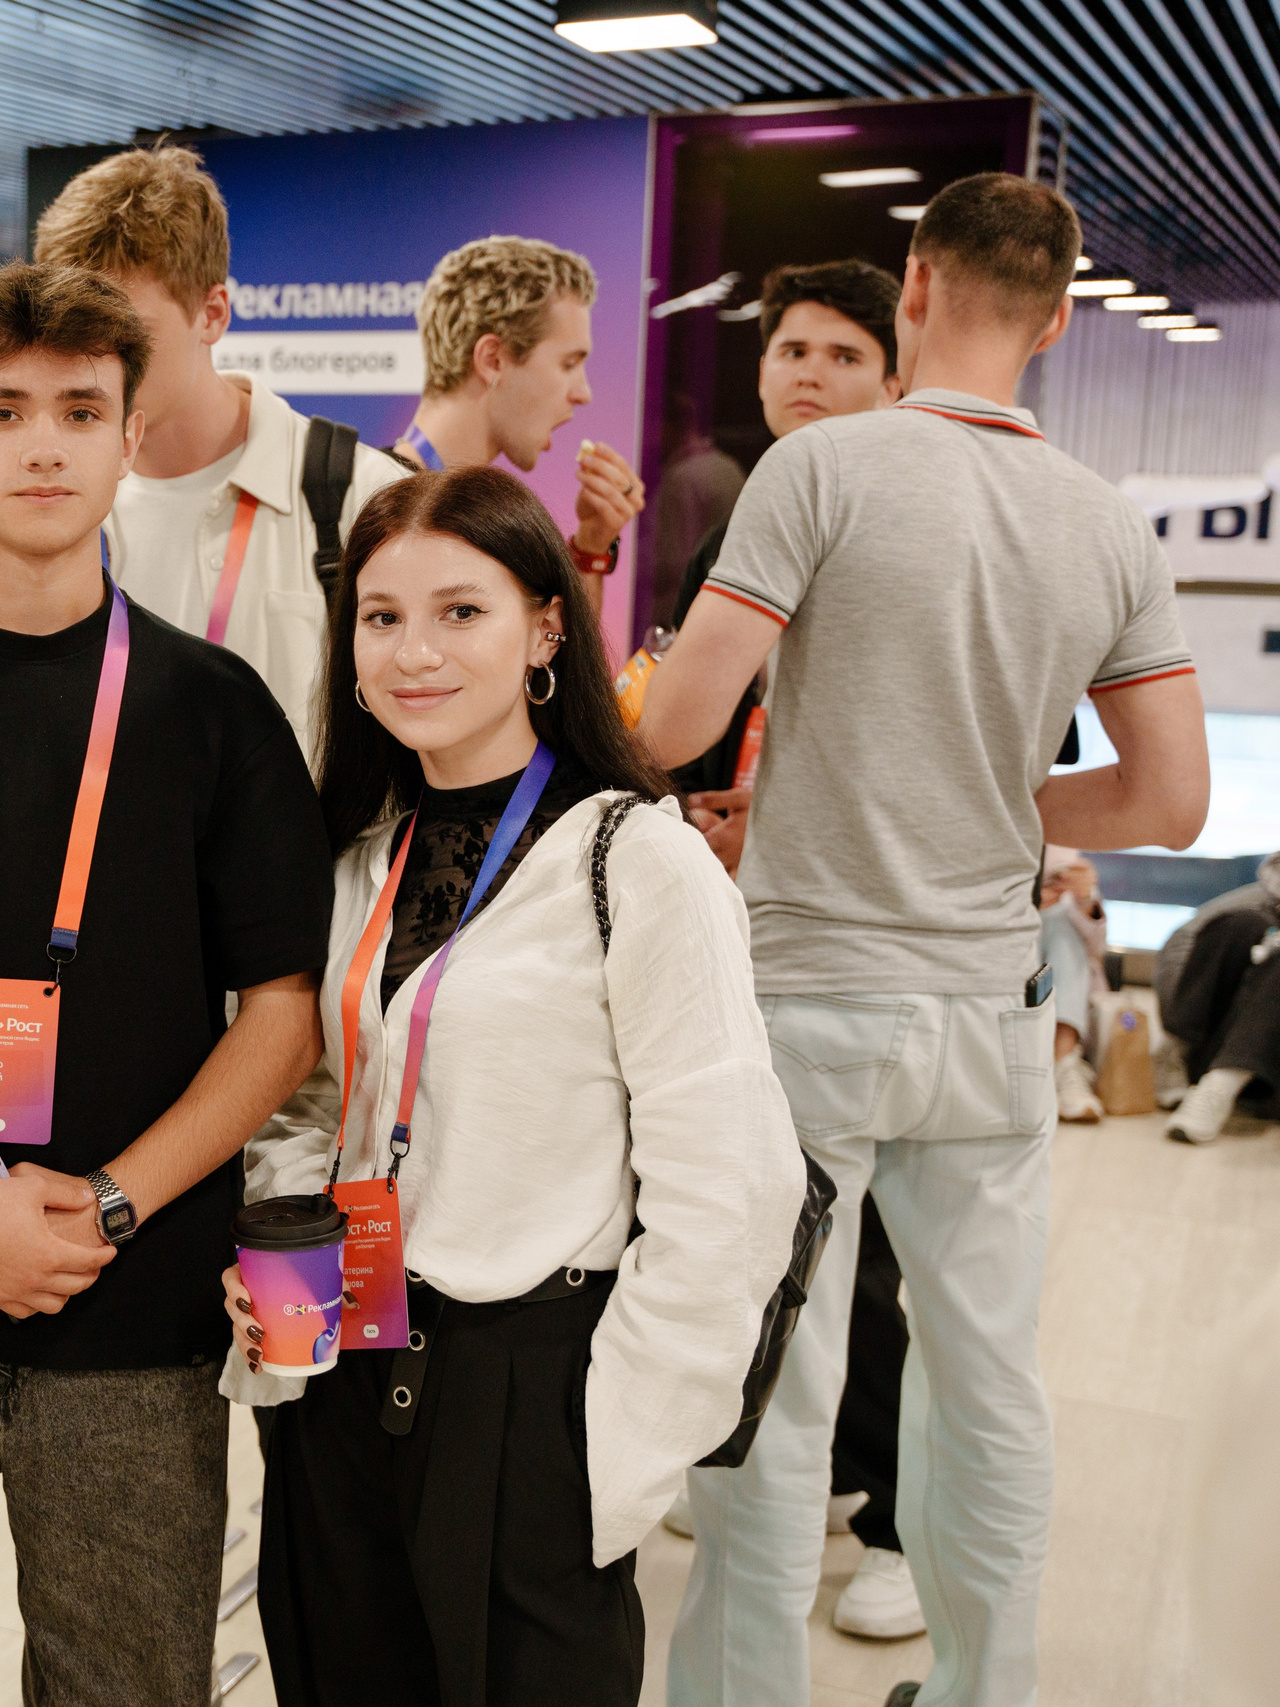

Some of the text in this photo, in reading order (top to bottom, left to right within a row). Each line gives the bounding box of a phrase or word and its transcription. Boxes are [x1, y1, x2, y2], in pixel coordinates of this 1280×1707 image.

[270, 346, 397, 378] блогеров
[7, 1018, 43, 1033] Рост
[348, 1219, 391, 1235] ст Рост
[344, 1267, 373, 1276] атерина
[349, 1280, 364, 1288] ова
